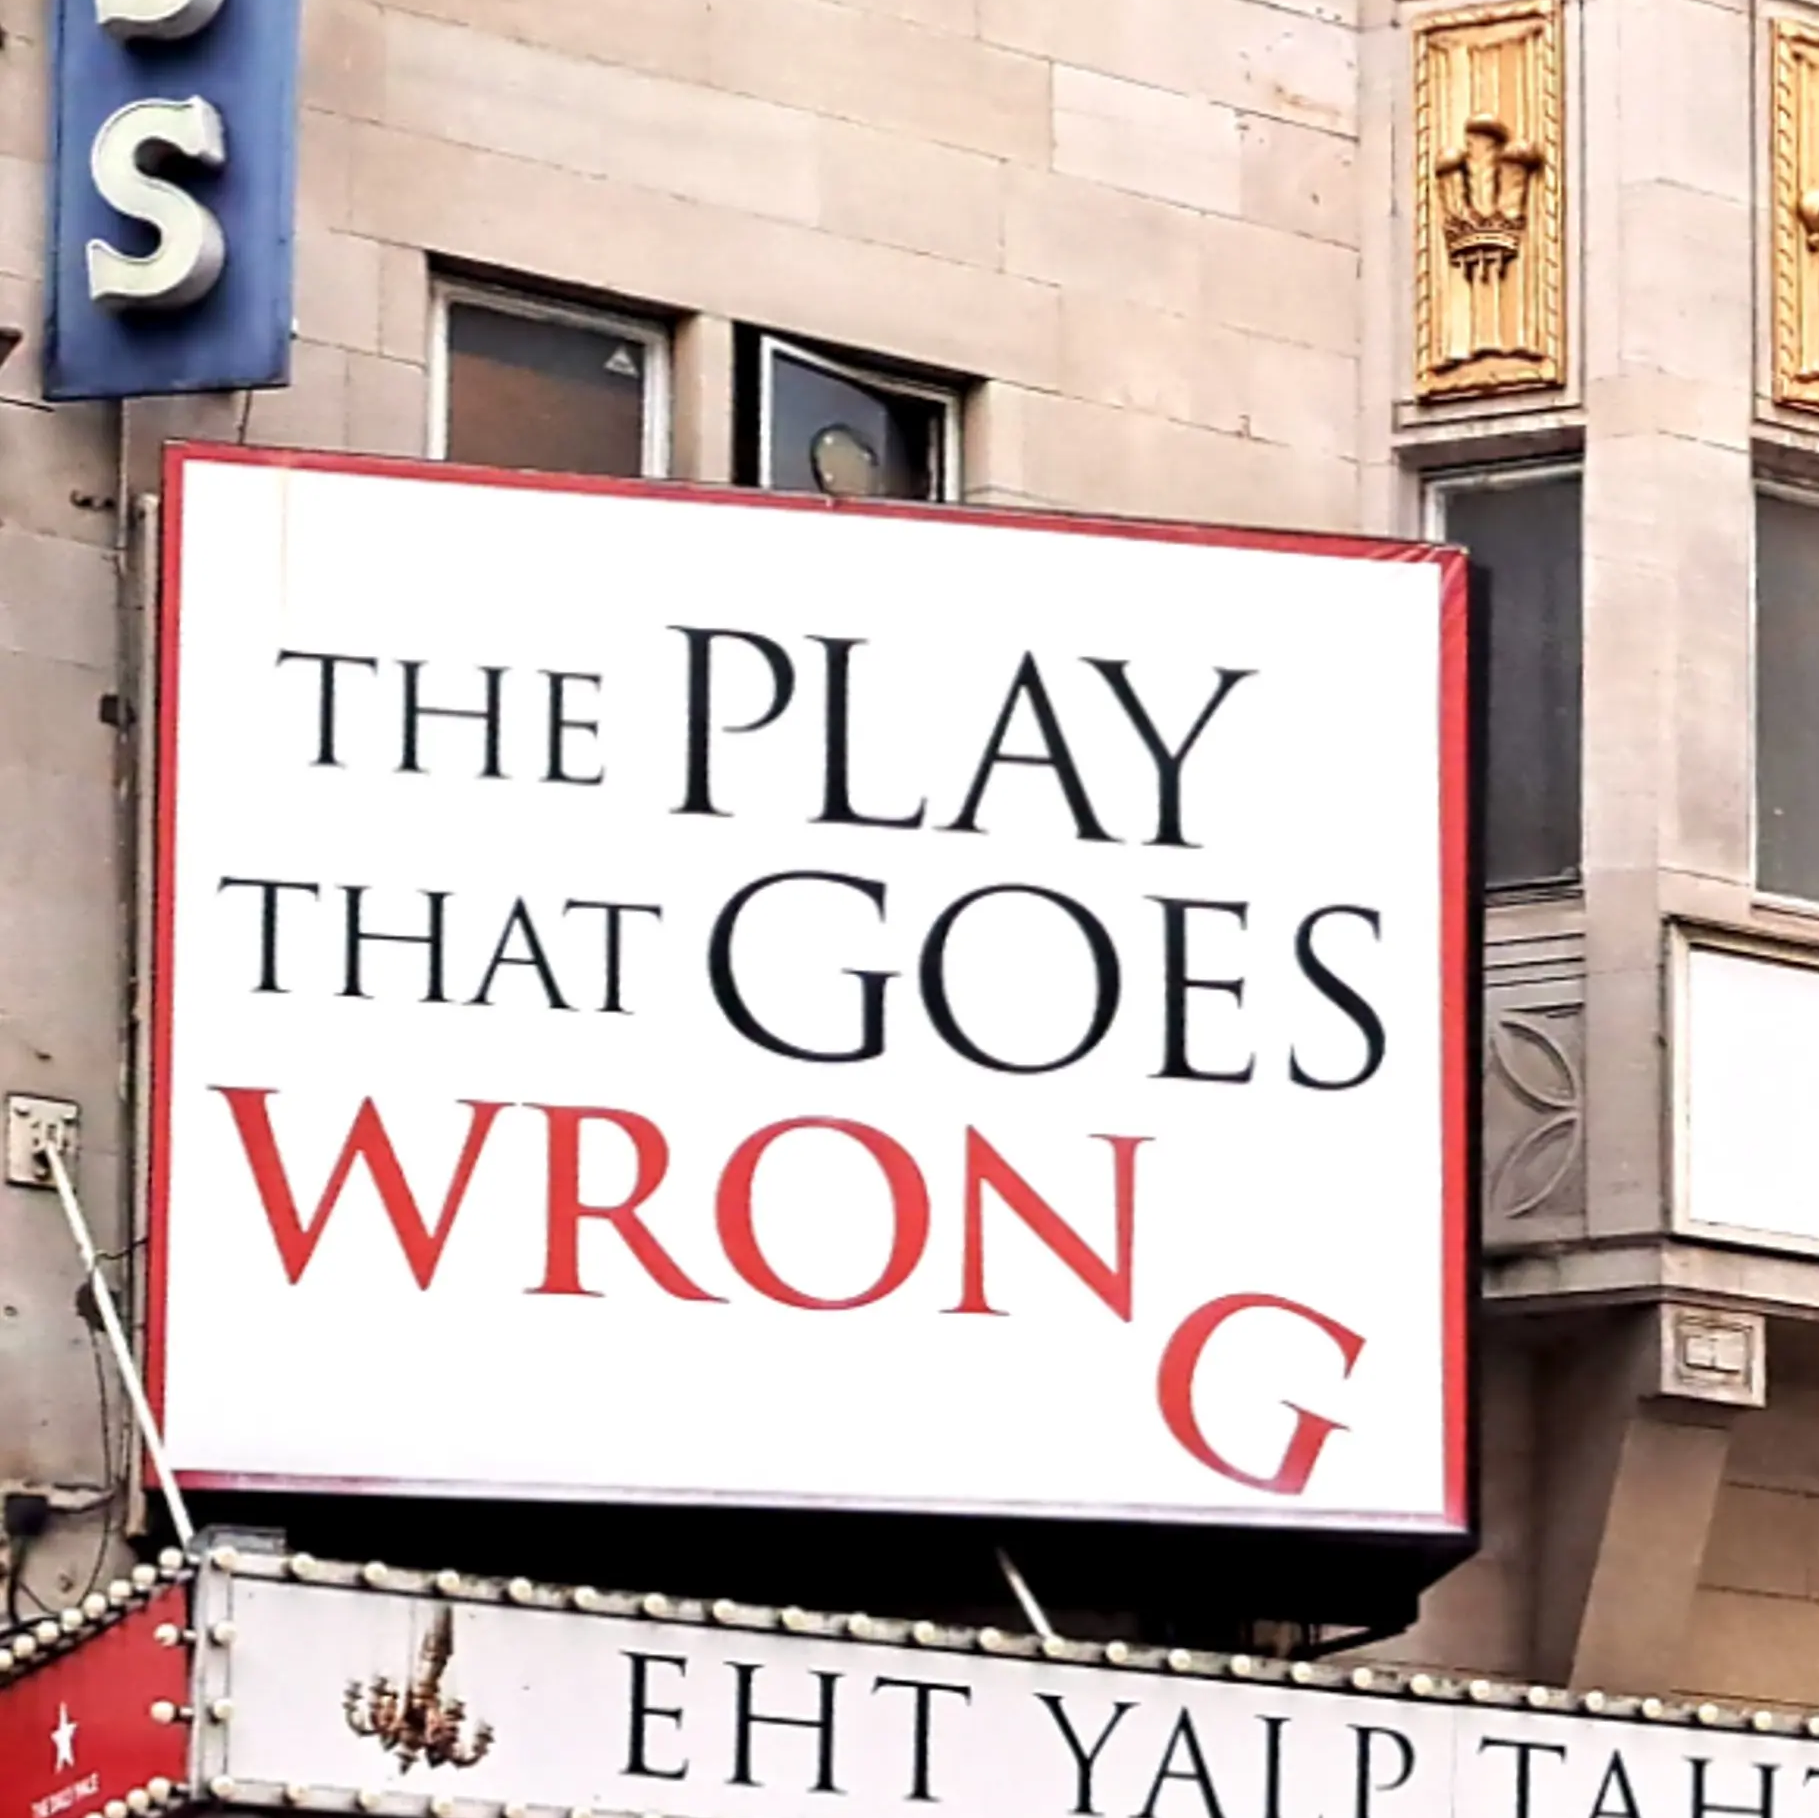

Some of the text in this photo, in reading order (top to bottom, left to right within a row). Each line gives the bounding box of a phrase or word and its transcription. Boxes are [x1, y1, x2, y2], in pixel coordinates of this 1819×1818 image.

[275, 624, 1258, 849] THE PLAY
[217, 869, 1388, 1092] THAT GOES
[206, 1084, 1368, 1496] WRONG
[618, 1649, 973, 1803] EHT
